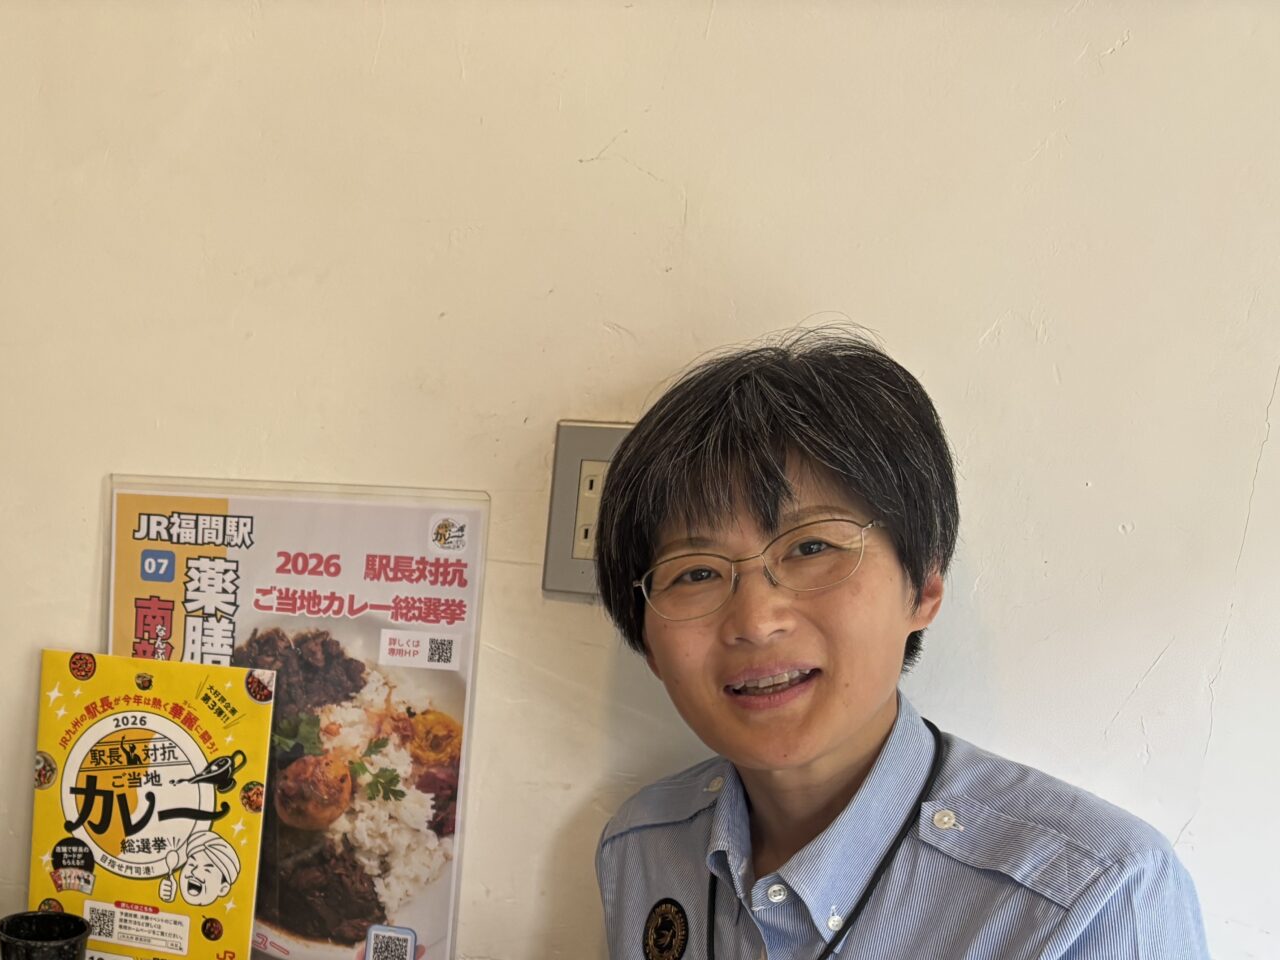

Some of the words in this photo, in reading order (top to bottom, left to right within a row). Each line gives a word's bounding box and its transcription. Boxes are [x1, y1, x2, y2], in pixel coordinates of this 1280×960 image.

[133, 512, 254, 549] JR福間駅
[144, 557, 169, 575] 07
[275, 551, 342, 577] 2026
[364, 554, 468, 588] 駅長対抗
[253, 586, 467, 625] ご当地カレー総選挙
[112, 715, 147, 728] 2026
[89, 748, 122, 766] 駅長
[142, 743, 179, 762] 対抗
[112, 770, 162, 789] ご当地
[64, 775, 231, 837] カレー
[120, 837, 168, 855] 総選挙
